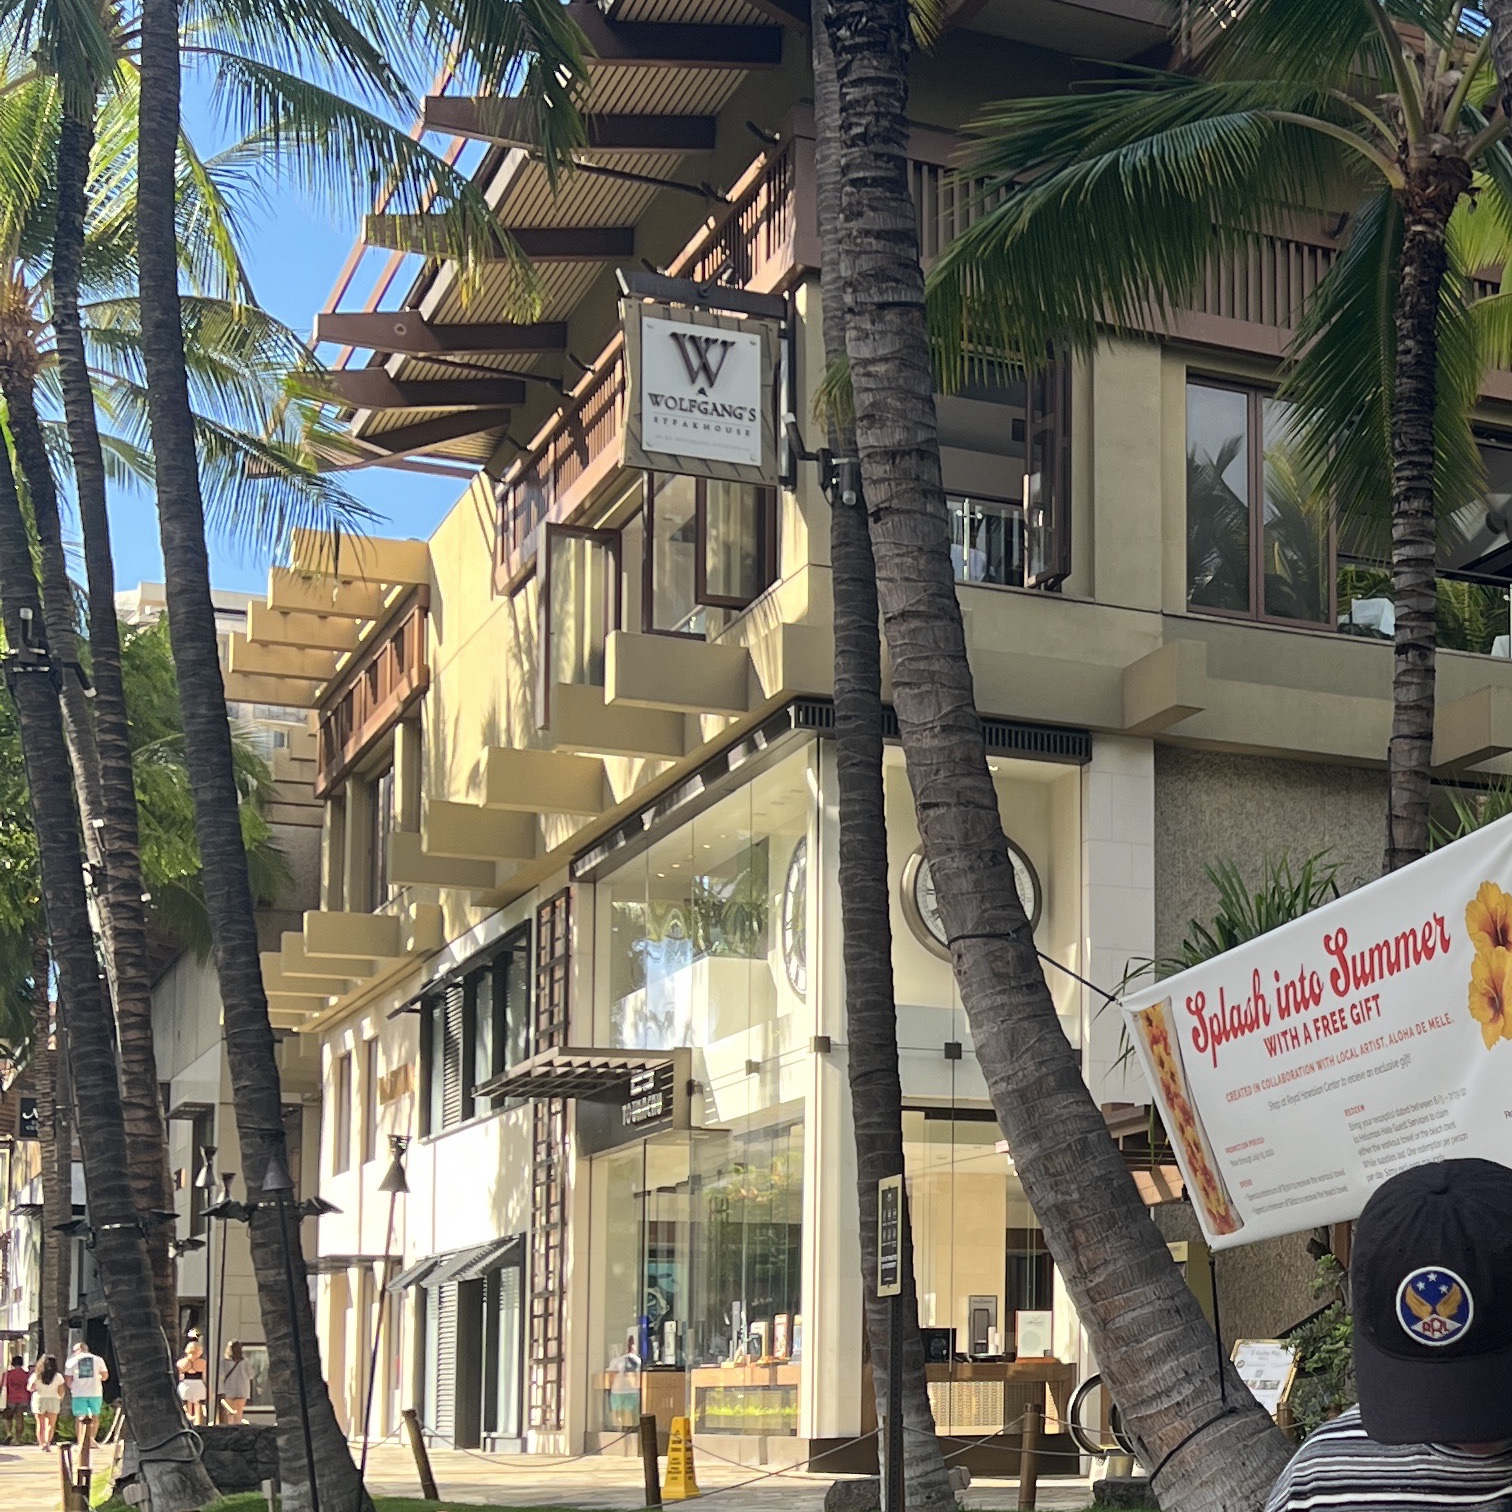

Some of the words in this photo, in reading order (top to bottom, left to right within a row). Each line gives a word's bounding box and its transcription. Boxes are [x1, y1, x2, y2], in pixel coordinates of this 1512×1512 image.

[670, 332, 736, 388] W
[647, 392, 757, 422] WOLFGANG'S
[653, 416, 750, 437] STEAKHOUSE
[1186, 967, 1271, 1068] Splash
[1274, 963, 1324, 1020] into
[1323, 912, 1451, 997] Summer
[1263, 1026, 1300, 1058] WITH
[1303, 1022, 1313, 1045] A
[1313, 1007, 1348, 1040] FREE
[1350, 993, 1381, 1026] GIFT
[1226, 1086, 1253, 1102] CREATED
[1253, 1083, 1261, 1093] IN
[1261, 1063, 1316, 1090] COLLABORATION
[1316, 1056, 1336, 1070] WITH
[1336, 1047, 1360, 1063] LOCAL
[1359, 1036, 1388, 1056] ARTIST,
[1387, 1026, 1415, 1045] ALOHA
[1416, 1022, 1428, 1035] DE
[1428, 1012, 1455, 1030] MELE.
